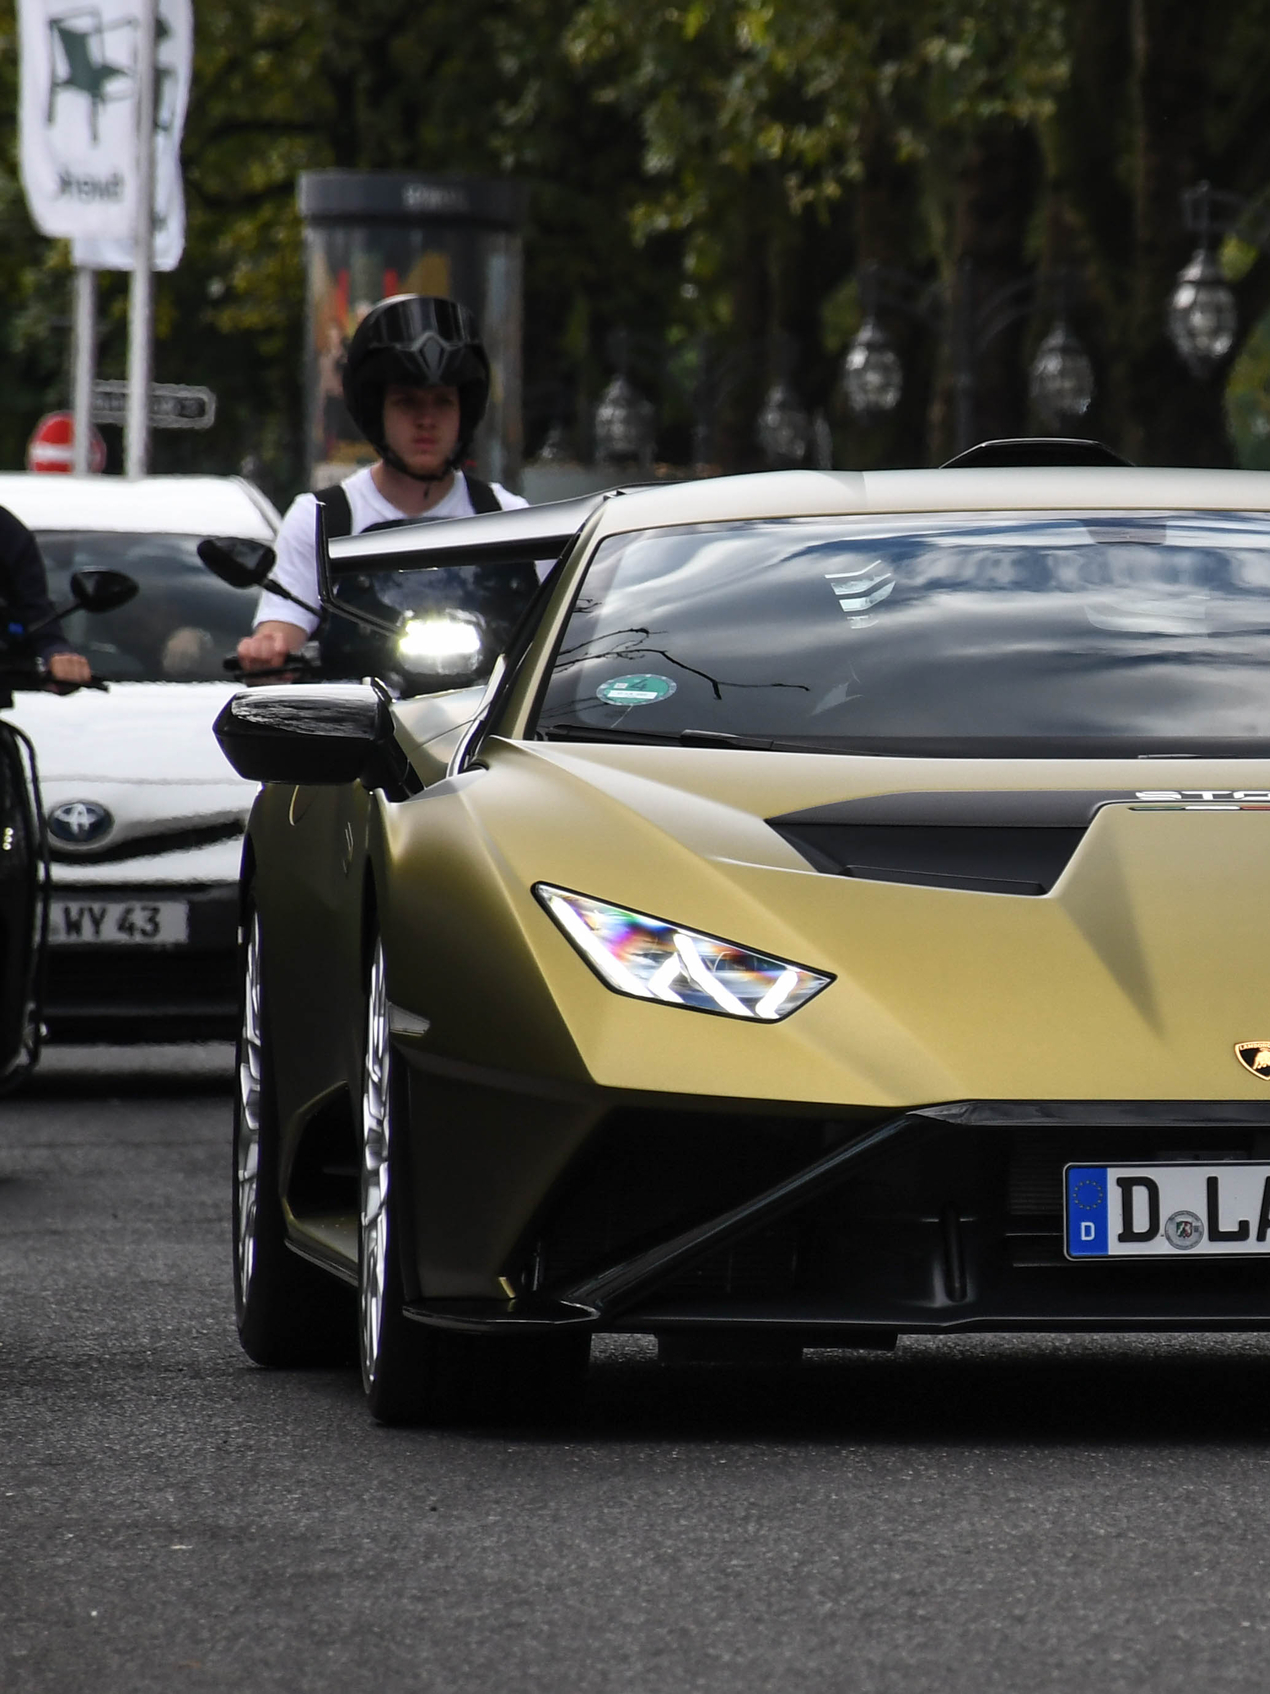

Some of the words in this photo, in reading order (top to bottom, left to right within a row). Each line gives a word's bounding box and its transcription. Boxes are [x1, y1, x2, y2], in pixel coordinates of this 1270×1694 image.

[630, 678, 648, 691] 4
[63, 906, 106, 937] WY
[117, 906, 160, 937] 43
[1117, 1176, 1160, 1243] D
[1081, 1222, 1095, 1241] D
